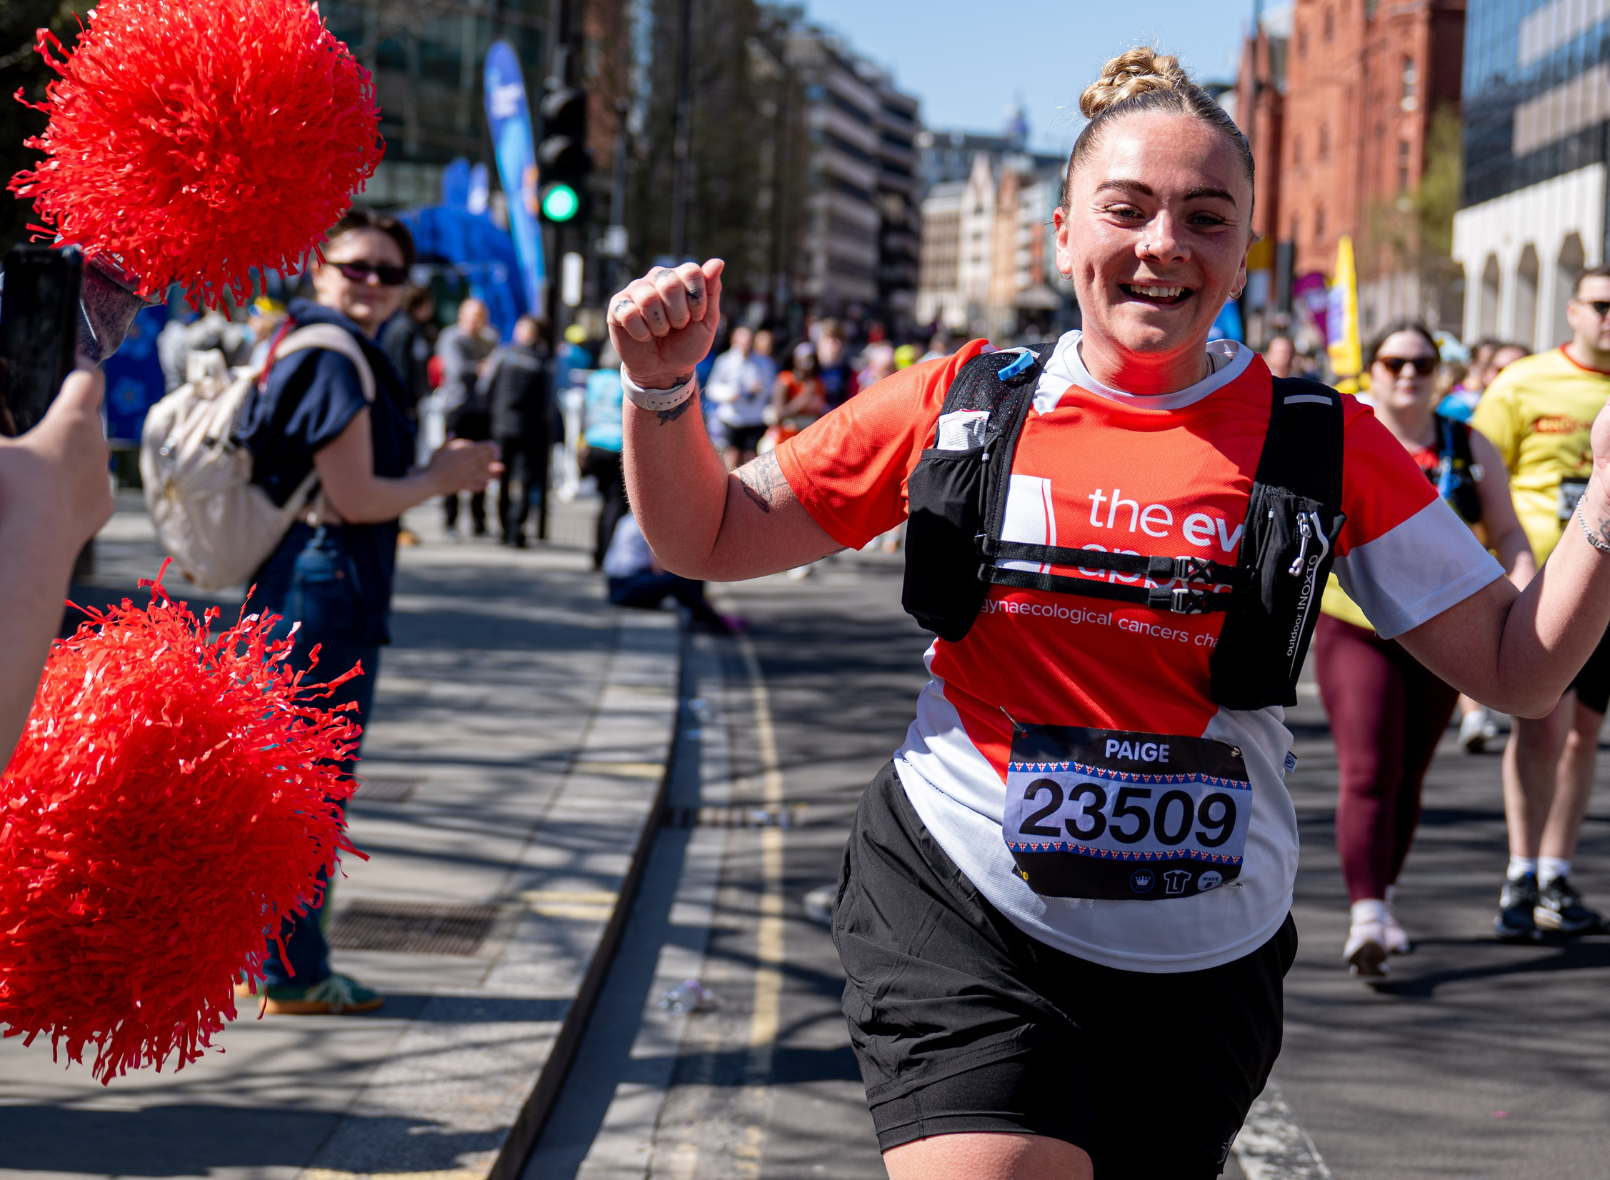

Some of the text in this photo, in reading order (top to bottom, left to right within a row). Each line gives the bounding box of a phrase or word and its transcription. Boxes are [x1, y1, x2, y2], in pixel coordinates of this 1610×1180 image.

[1088, 488, 1173, 538] the
[980, 598, 1113, 626] gynaecological
[1118, 617, 1189, 642] cancers
[1287, 554, 1319, 657] outdoor INOXTO
[1105, 739, 1170, 763] PAIGE
[1018, 778, 1237, 848] 23509
